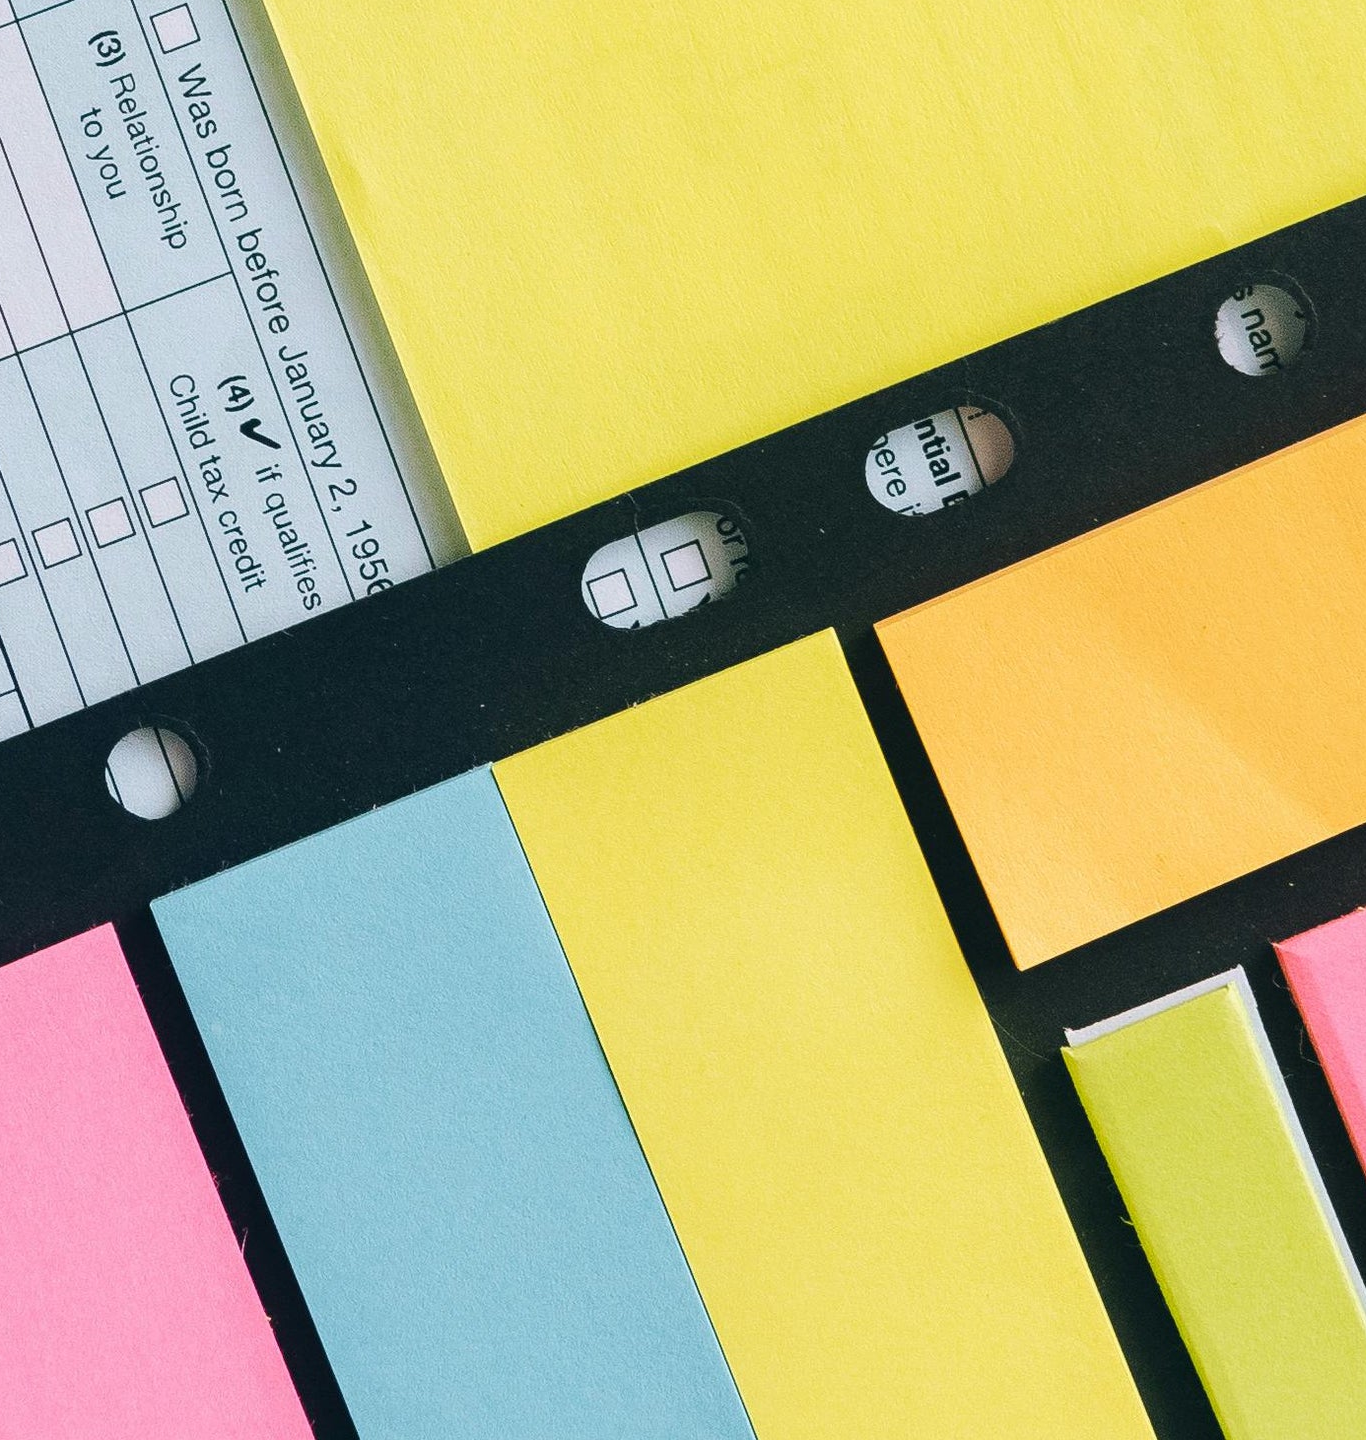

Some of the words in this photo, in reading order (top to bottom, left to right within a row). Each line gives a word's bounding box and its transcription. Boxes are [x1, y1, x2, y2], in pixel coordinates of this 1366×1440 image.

[79, 106, 104, 139] to
[87, 29, 127, 68] (3)
[108, 72, 189, 250] Relationship
[85, 144, 127, 200] you
[177, 62, 218, 140] Was
[204, 143, 249, 223] born
[235, 227, 290, 335] before
[277, 345, 343, 469] January
[327, 477, 358, 513] 2,
[216, 374, 255, 413] (4)
[169, 373, 217, 451] Child
[198, 454, 230, 505] tax
[217, 509, 267, 594] credit
[254, 463, 284, 484] if
[261, 492, 322, 611] qualifies
